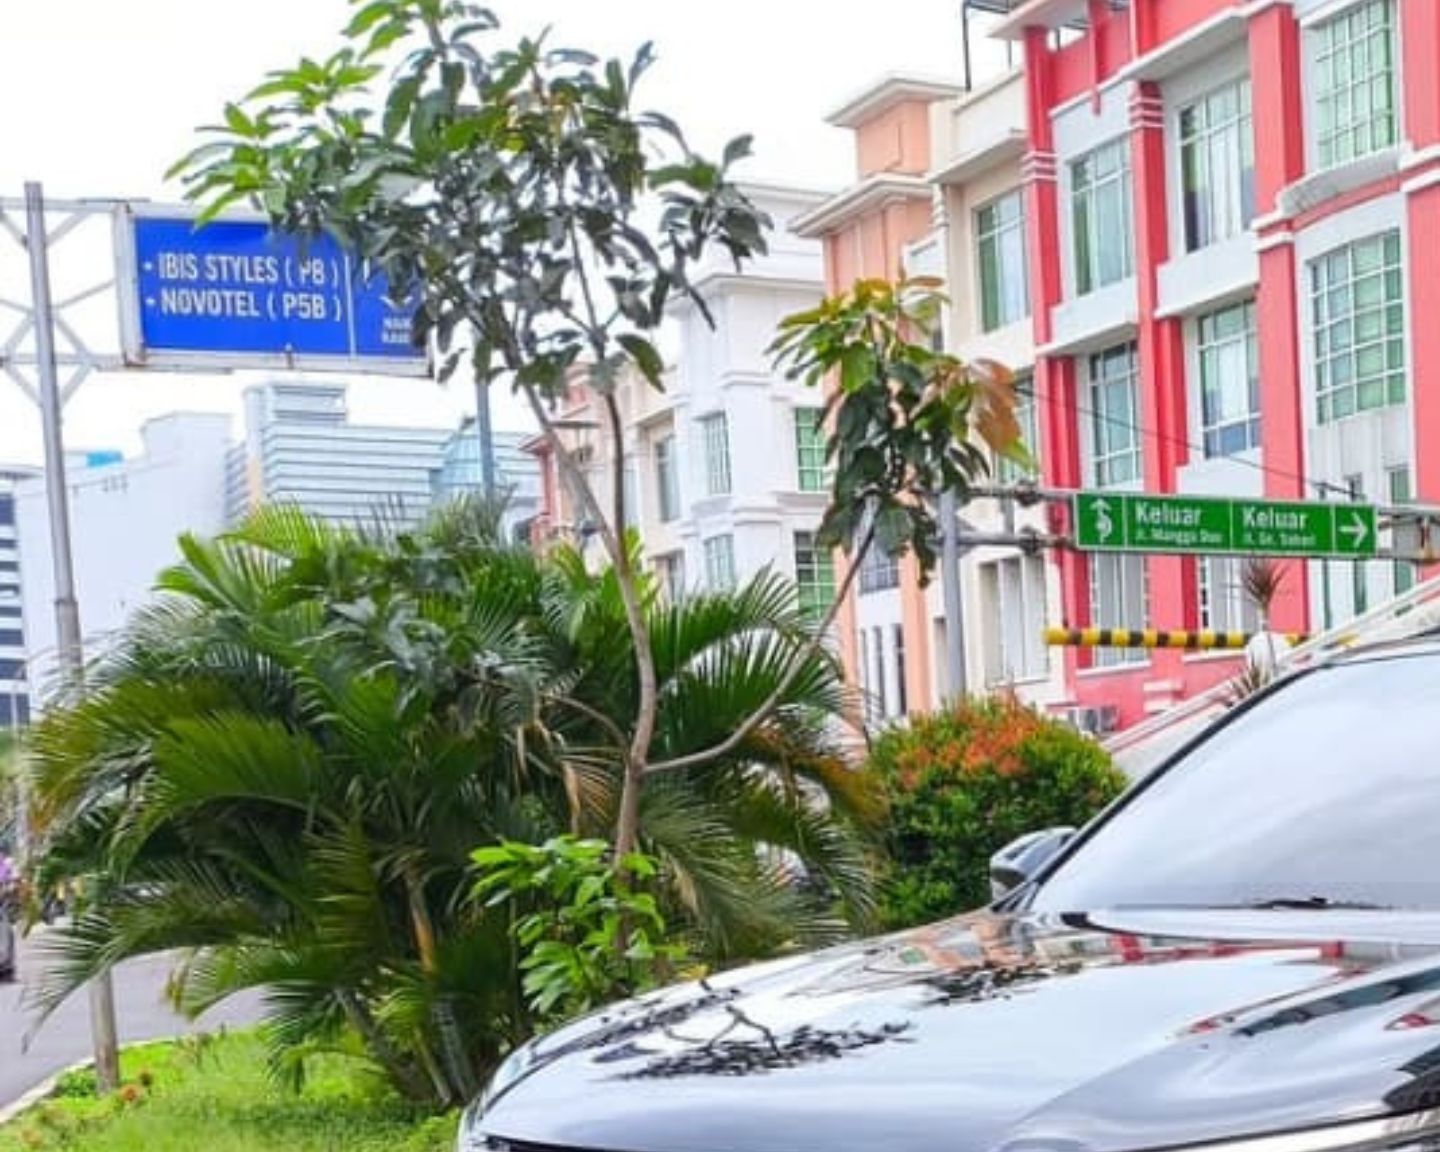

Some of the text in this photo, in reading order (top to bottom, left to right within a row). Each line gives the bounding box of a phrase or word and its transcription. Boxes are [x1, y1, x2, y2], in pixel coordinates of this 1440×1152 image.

[159, 252, 198, 279] IBIS
[204, 253, 279, 283] STYLES
[161, 287, 260, 318] NOVOTEL
[1135, 501, 1202, 526] Keluar
[1242, 506, 1308, 529] Keluar
